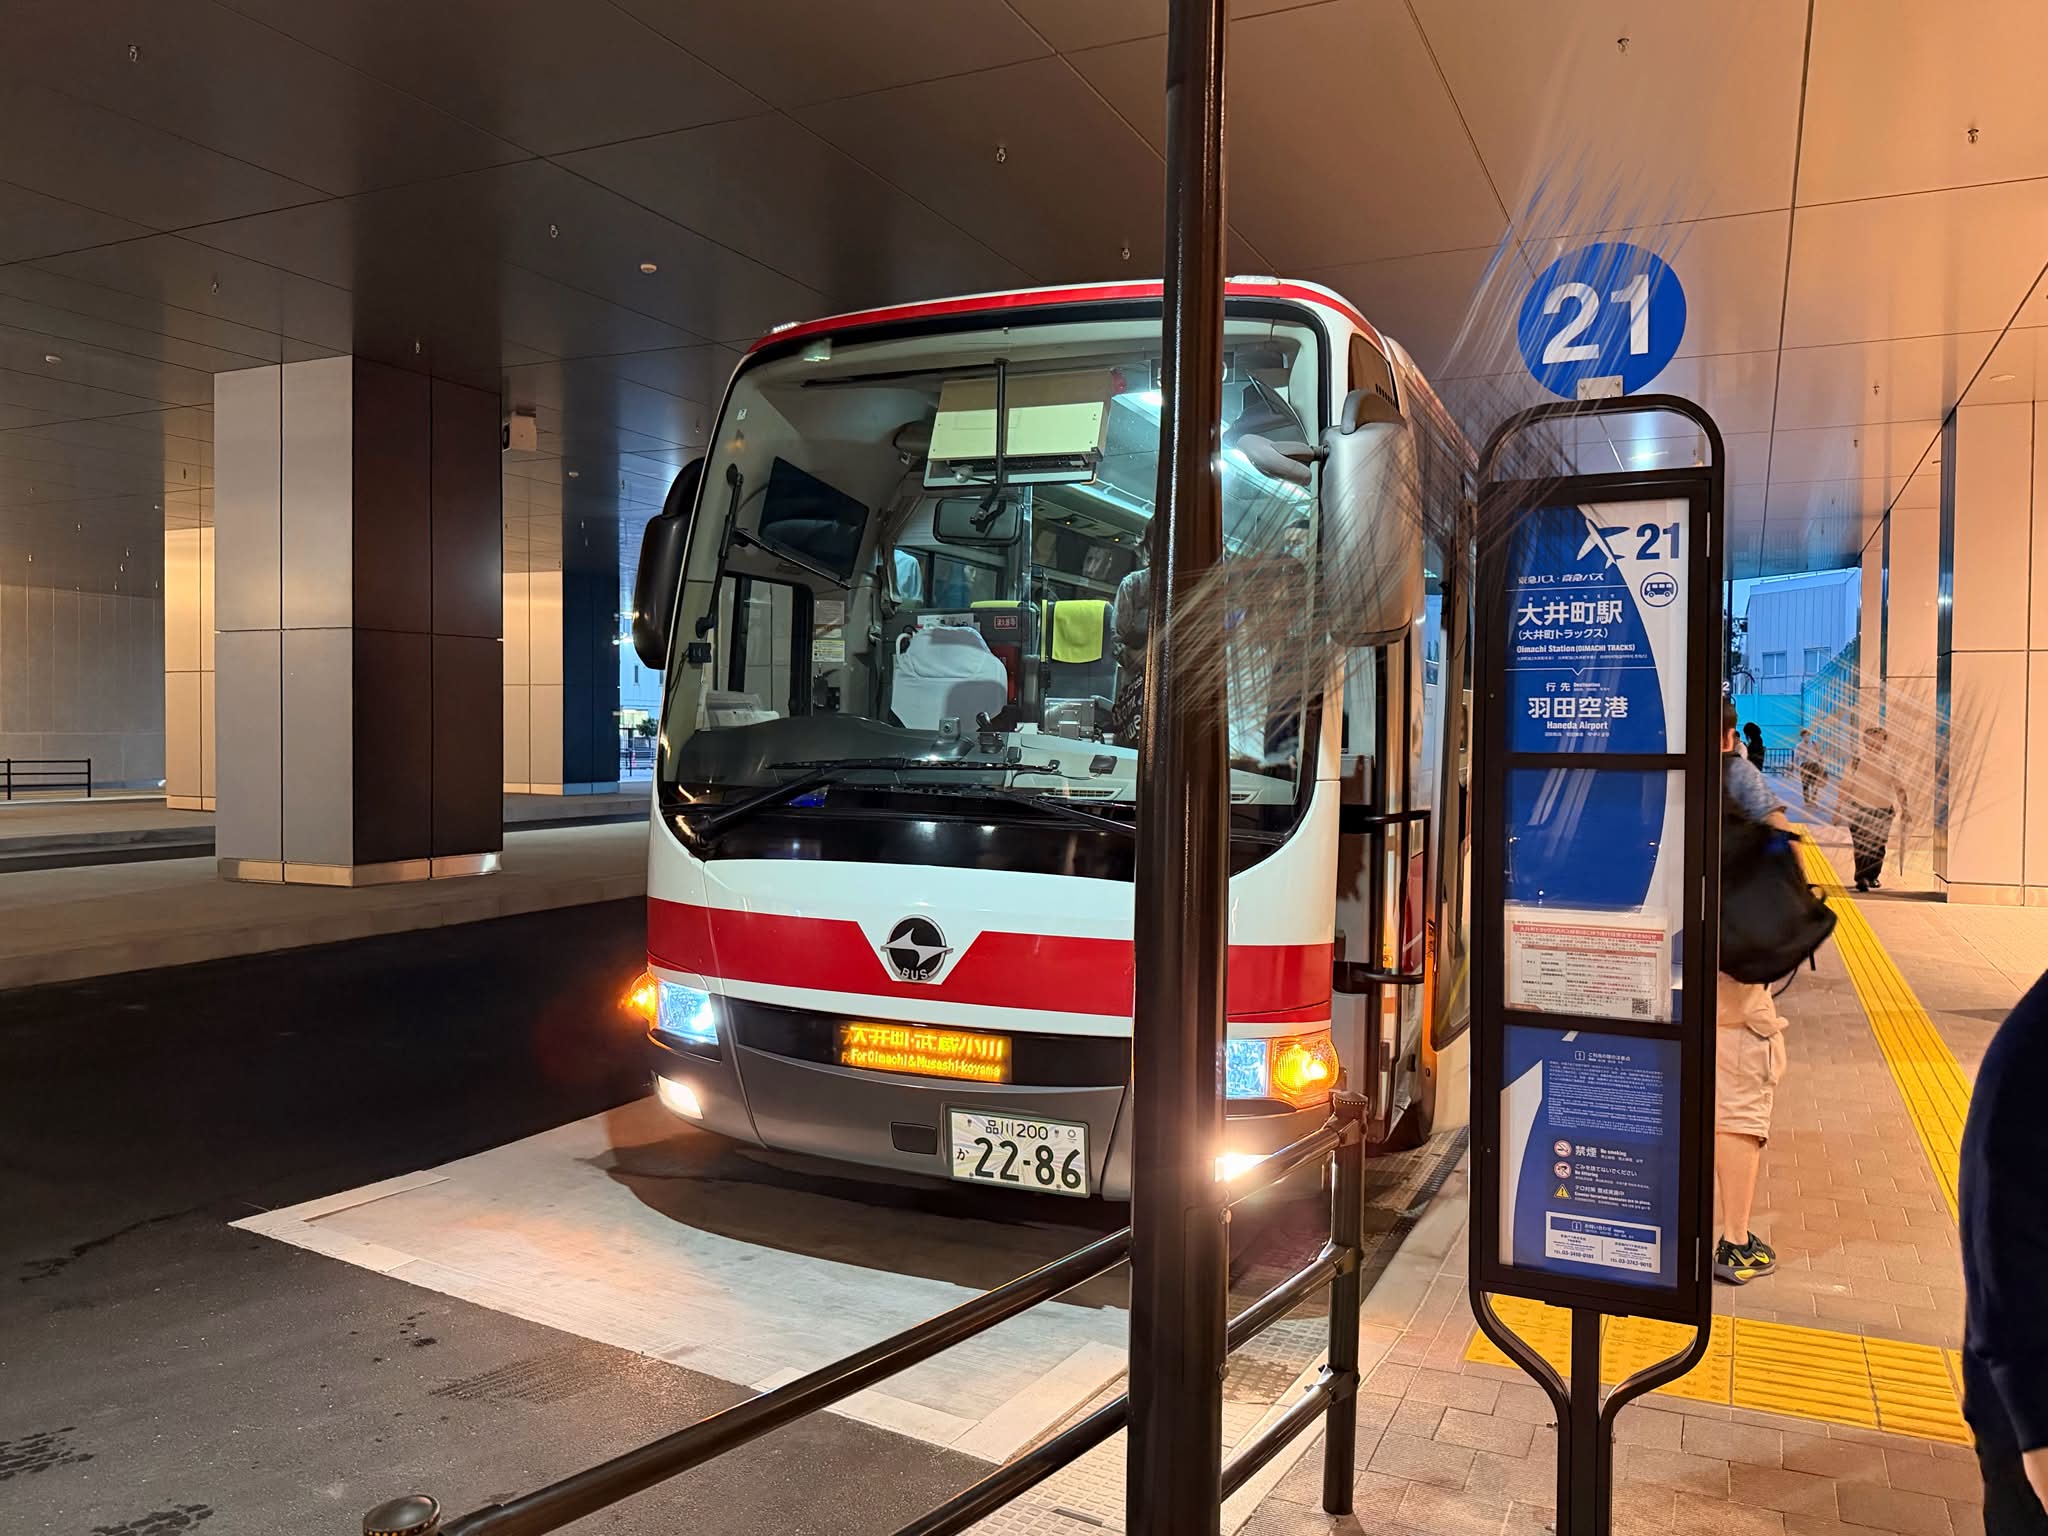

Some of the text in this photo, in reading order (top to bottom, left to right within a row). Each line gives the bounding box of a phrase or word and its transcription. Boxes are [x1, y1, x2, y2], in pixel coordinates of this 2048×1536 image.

[1542, 273, 1649, 365] 21
[1635, 522, 1680, 561] 21
[1517, 600, 1623, 626] 大井町駅
[1516, 645, 1547, 653] Oimachi
[1528, 696, 1628, 718] 羽田空港
[1546, 720, 1608, 731] Haneda Airport
[901, 967, 929, 980] BUS
[1575, 1145, 1597, 1158] 禁煙
[974, 1137, 1081, 1189] 22-86
